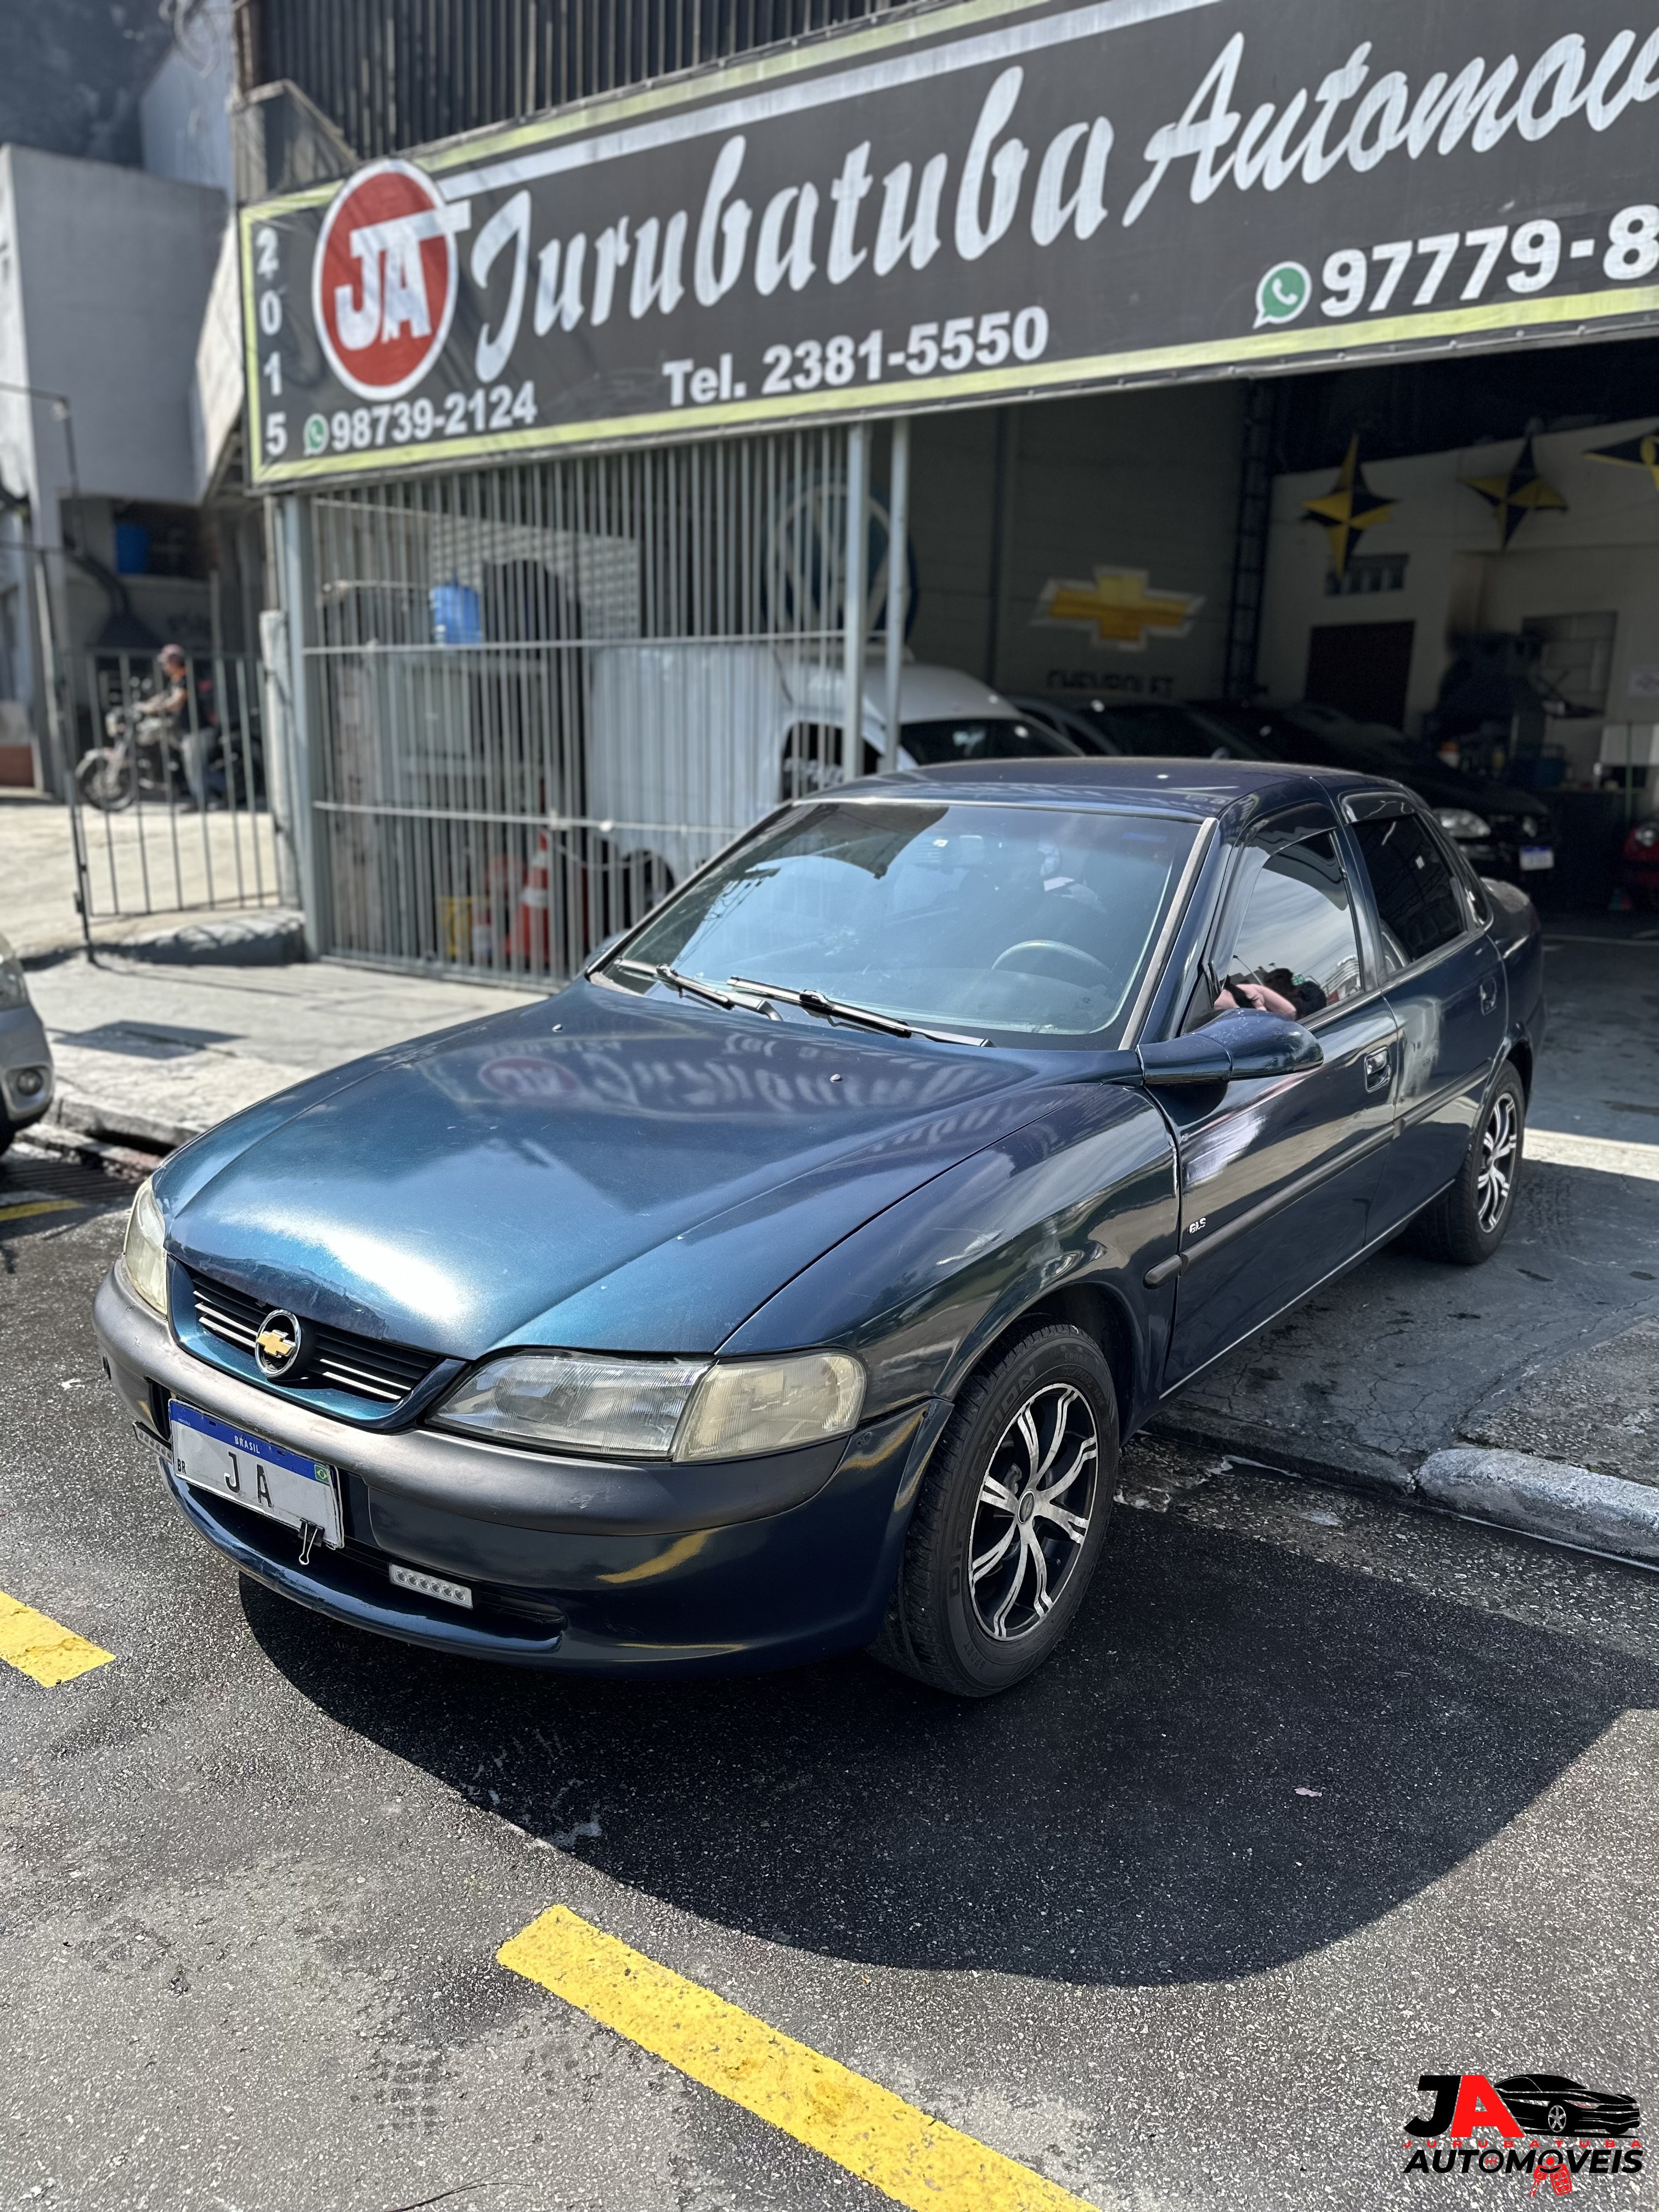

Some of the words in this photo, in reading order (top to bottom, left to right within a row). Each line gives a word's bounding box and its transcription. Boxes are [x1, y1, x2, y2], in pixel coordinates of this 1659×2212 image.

[471, 66, 1114, 382] Jurubatuba
[334, 200, 471, 351] JA
[662, 353, 747, 407] Tel.
[762, 306, 1049, 394] 2381-5550
[331, 380, 538, 452] 98739-2124
[177, 1458, 187, 1475] BR
[234, 1435, 261, 1454] BRASIL
